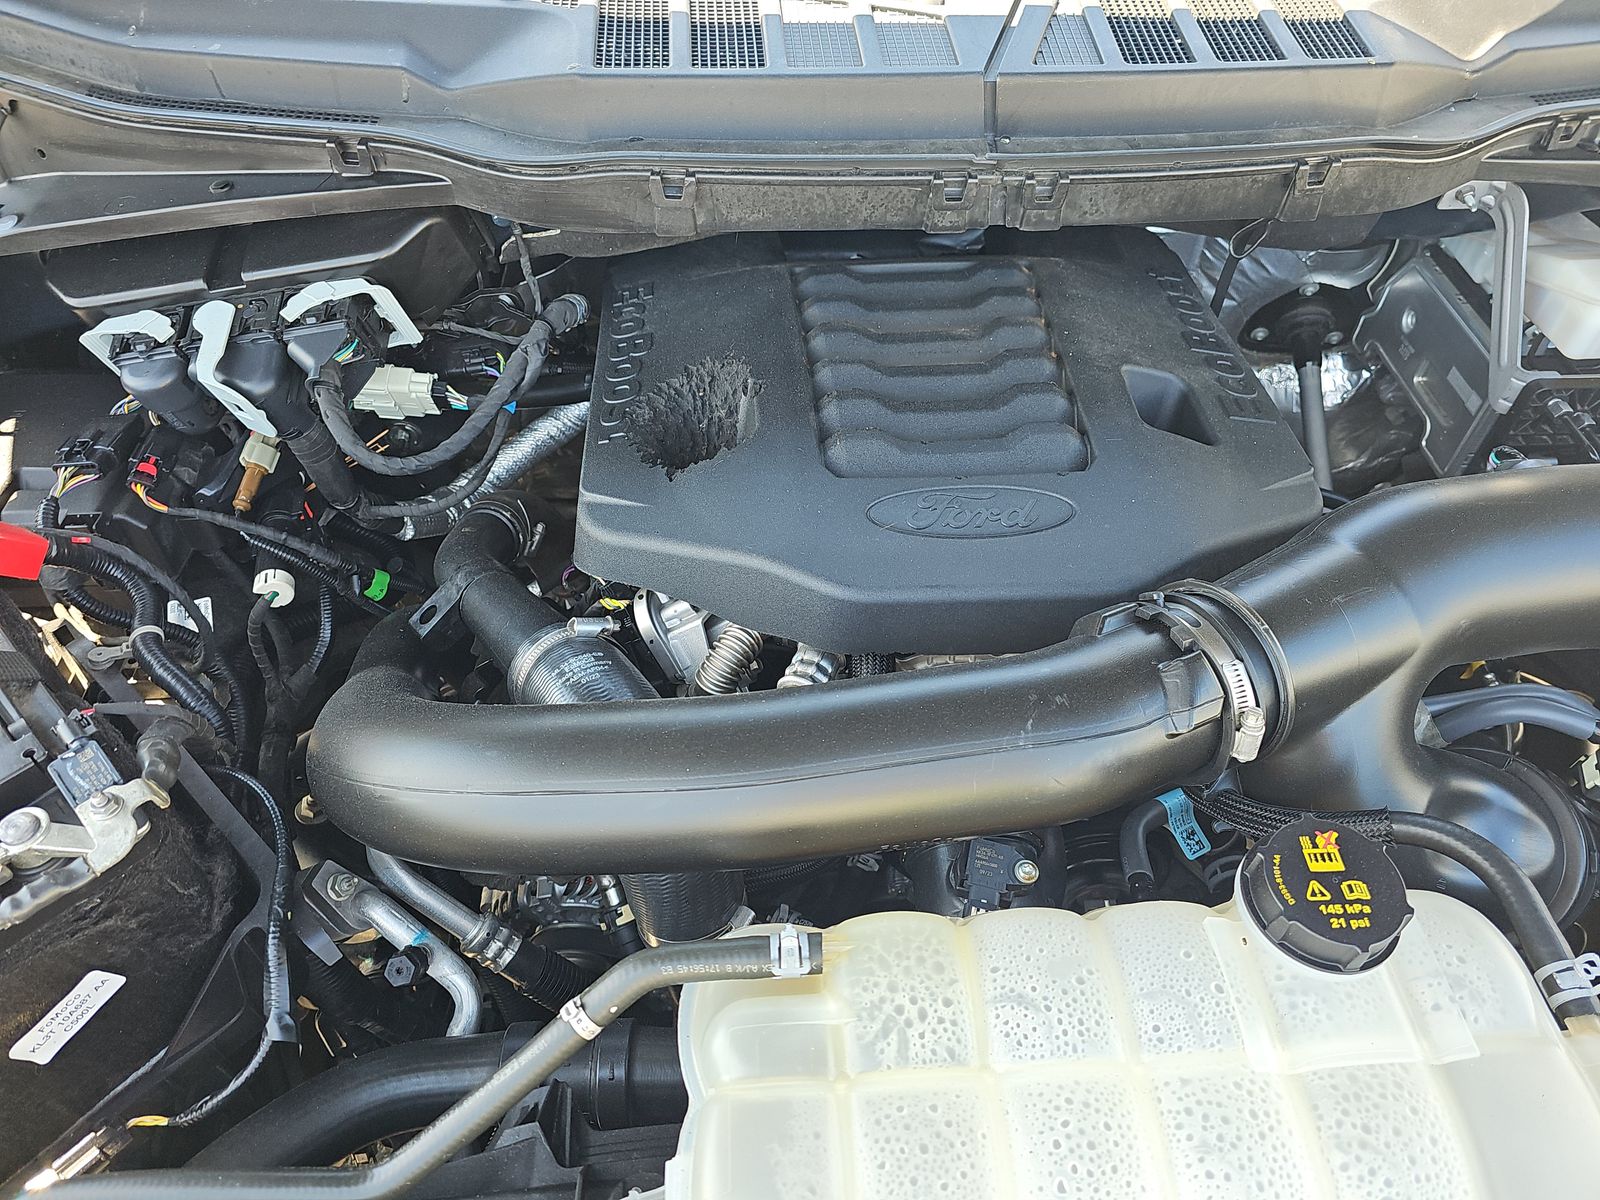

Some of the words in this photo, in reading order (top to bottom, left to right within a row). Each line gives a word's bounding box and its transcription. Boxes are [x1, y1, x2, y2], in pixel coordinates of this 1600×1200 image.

[906, 492, 1040, 530] Ford
[1319, 904, 1344, 915] 145
[1344, 903, 1372, 915] kPa
[1329, 917, 1347, 929] 21
[1349, 917, 1371, 930] psi
[29, 1028, 56, 1054] KL3T
[94, 978, 110, 992] AA
[38, 993, 82, 1033] FoMoCo
[64, 1003, 97, 1033] C500L
